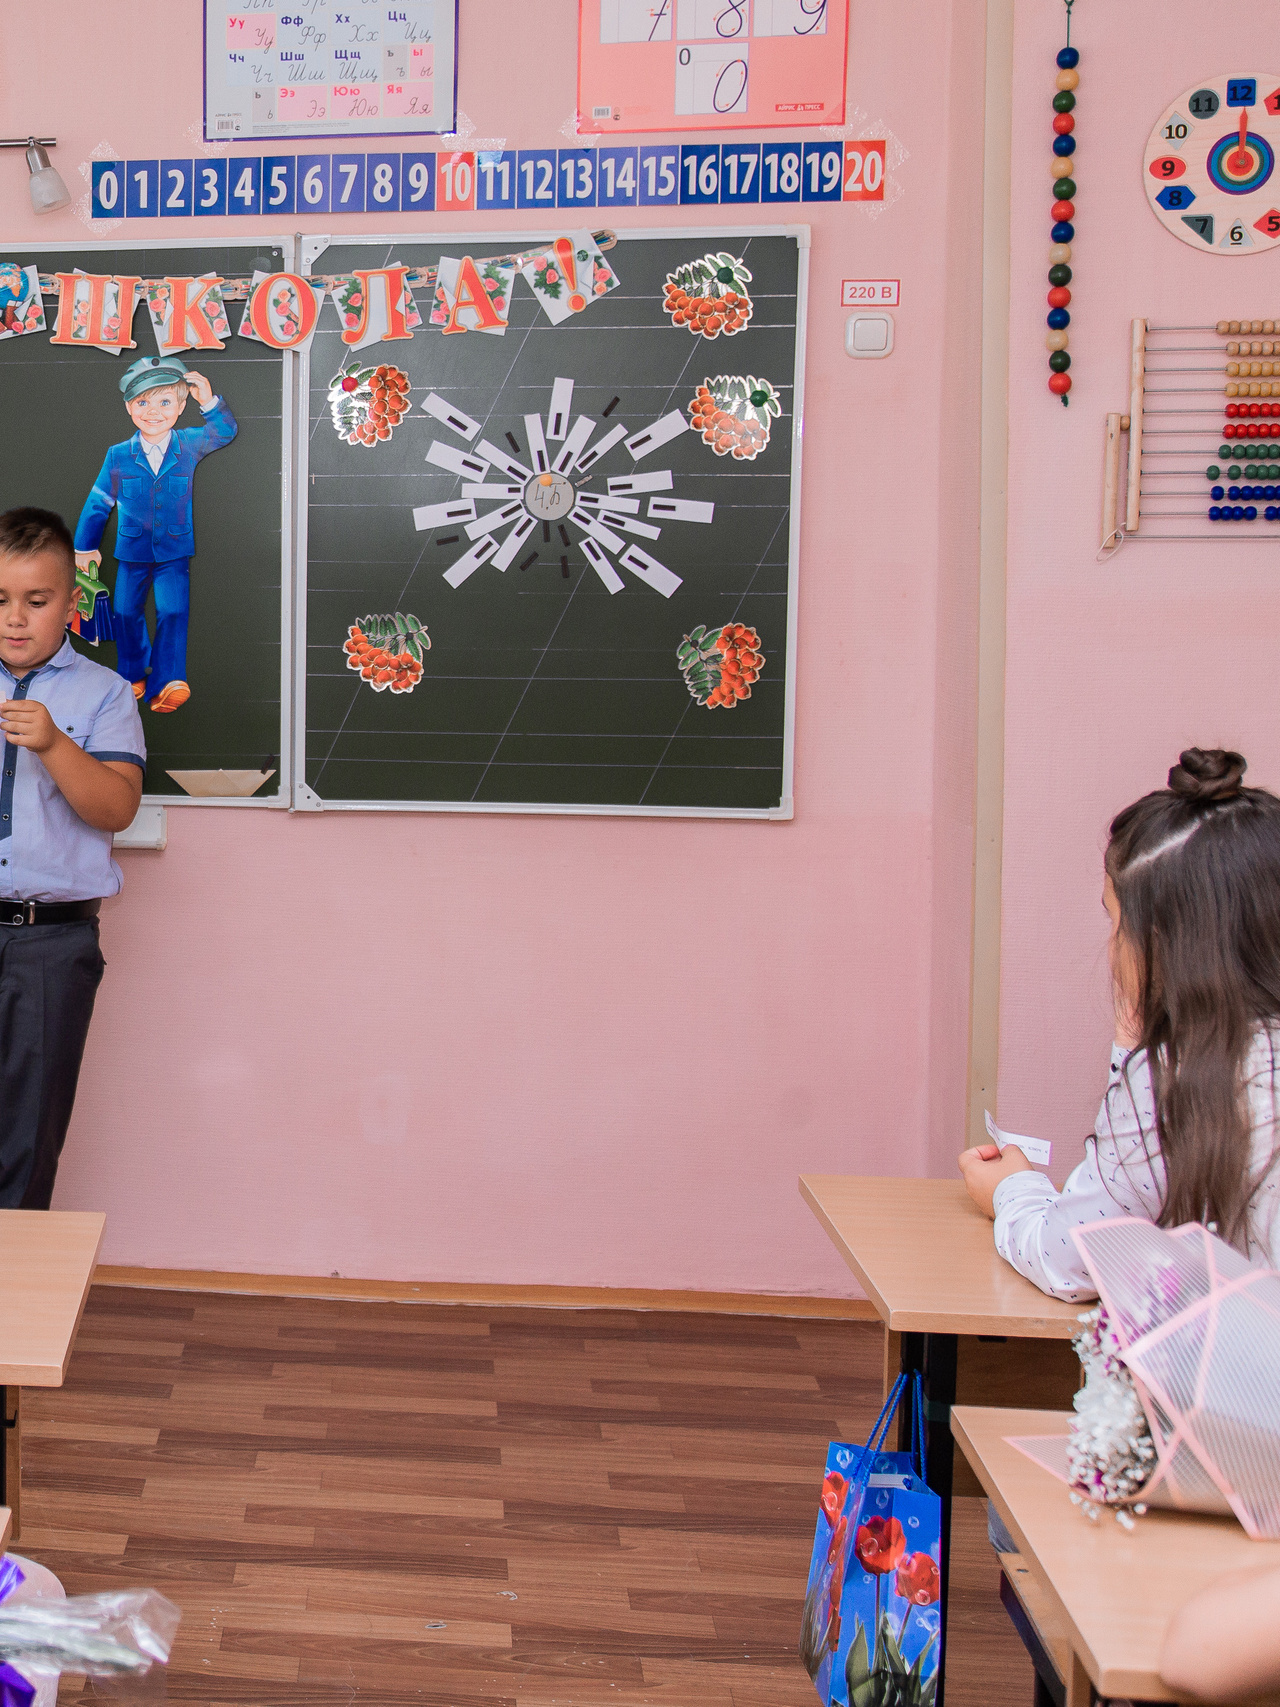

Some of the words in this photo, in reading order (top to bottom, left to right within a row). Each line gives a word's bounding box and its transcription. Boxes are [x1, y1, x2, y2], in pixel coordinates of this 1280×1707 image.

[716, 0, 746, 38] 8
[793, 0, 827, 35] 9
[1229, 86, 1252, 101] 12
[1192, 98, 1214, 113] 11
[1165, 124, 1187, 139] 10
[1162, 161, 1175, 176] 9
[99, 171, 118, 210] 0
[134, 170, 148, 209] 1
[167, 169, 185, 208] 2
[200, 168, 218, 207] 3
[234, 167, 255, 206] 4
[269, 166, 287, 205] 5
[303, 165, 323, 204] 6
[339, 164, 358, 203] 7
[373, 163, 393, 203] 8
[408, 162, 428, 203] 9
[440, 162, 470, 202] 10
[481, 160, 510, 201] 11
[521, 159, 553, 200] 12
[561, 158, 593, 199] 13
[601, 157, 636, 198] 14
[643, 155, 675, 197] 15
[683, 155, 717, 195] 16
[724, 153, 758, 195] 17
[765, 152, 799, 194] 18
[806, 151, 841, 193] 19
[845, 151, 883, 192] 20
[1169, 191, 1182, 206] 8
[1195, 219, 1208, 234] 7
[1267, 216, 1280, 231] 5
[1230, 226, 1242, 242] 6
[49, 237, 589, 351] ШКОЛА!
[849, 287, 875, 298] 220
